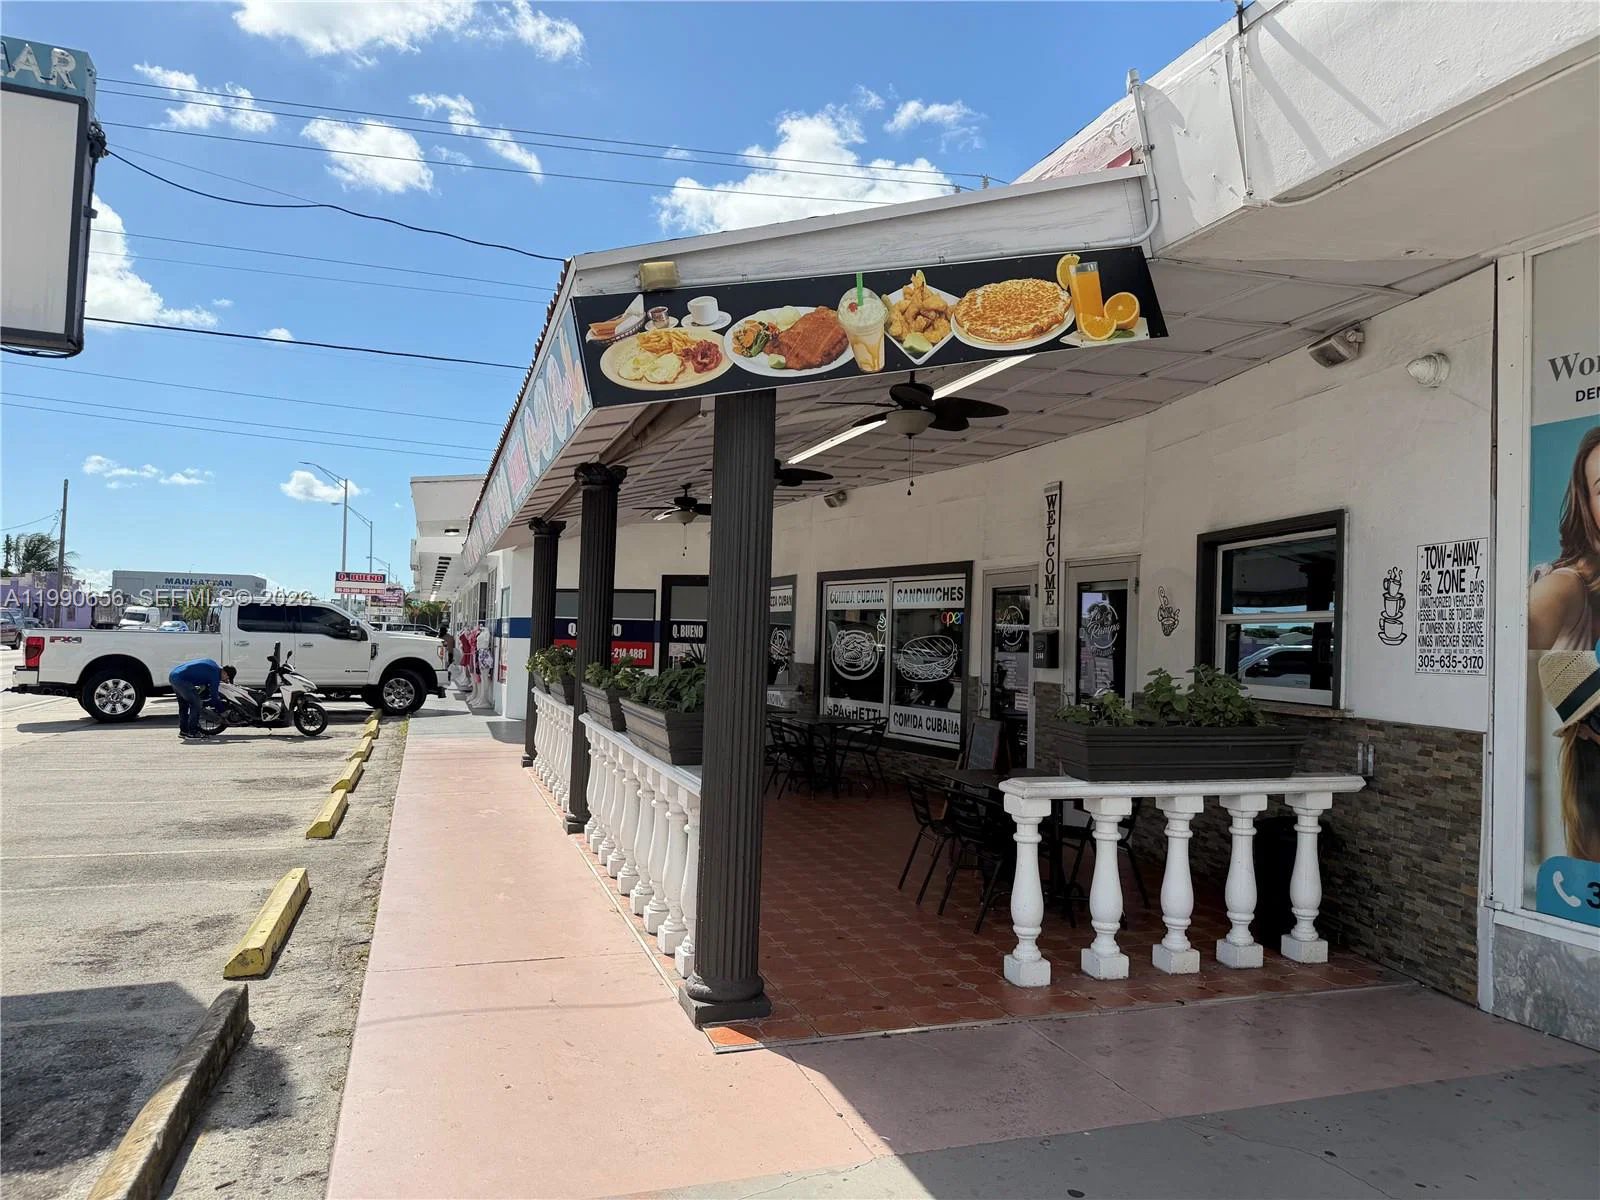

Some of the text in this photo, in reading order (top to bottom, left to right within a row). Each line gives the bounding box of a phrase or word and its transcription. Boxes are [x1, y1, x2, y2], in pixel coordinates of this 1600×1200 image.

[1044, 493, 1058, 606] WELCOME
[1424, 541, 1480, 570] TOW-AWAY
[349, 573, 384, 583] BUENO
[1421, 570, 1431, 583] 24
[1474, 566, 1480, 579] 7
[164, 577, 233, 587] MANHATTAN
[1437, 569, 1466, 594] ZONE
[1470, 580, 1485, 593] DAYS
[896, 586, 964, 603] SANDWICHES
[1419, 584, 1432, 596] HRS
[830, 589, 885, 605] COMIDA CUBANA
[1419, 594, 1484, 609] UNAUTHORIZED VEHICLES OR
[1418, 609, 1436, 621] VESSELS
[1449, 608, 1455, 620] BE
[1456, 608, 1472, 620] TOWED
[680, 625, 703, 638] BUENO
[1462, 621, 1483, 634] EXPENSE
[49, 636, 82, 644] FX4
[1418, 635, 1484, 648] KINGS WRECKER SERVICE
[1418, 655, 1484, 669] 305-635-3170
[827, 703, 881, 722] SPAGHETTI
[893, 711, 960, 736] COMIDA CUBANA
